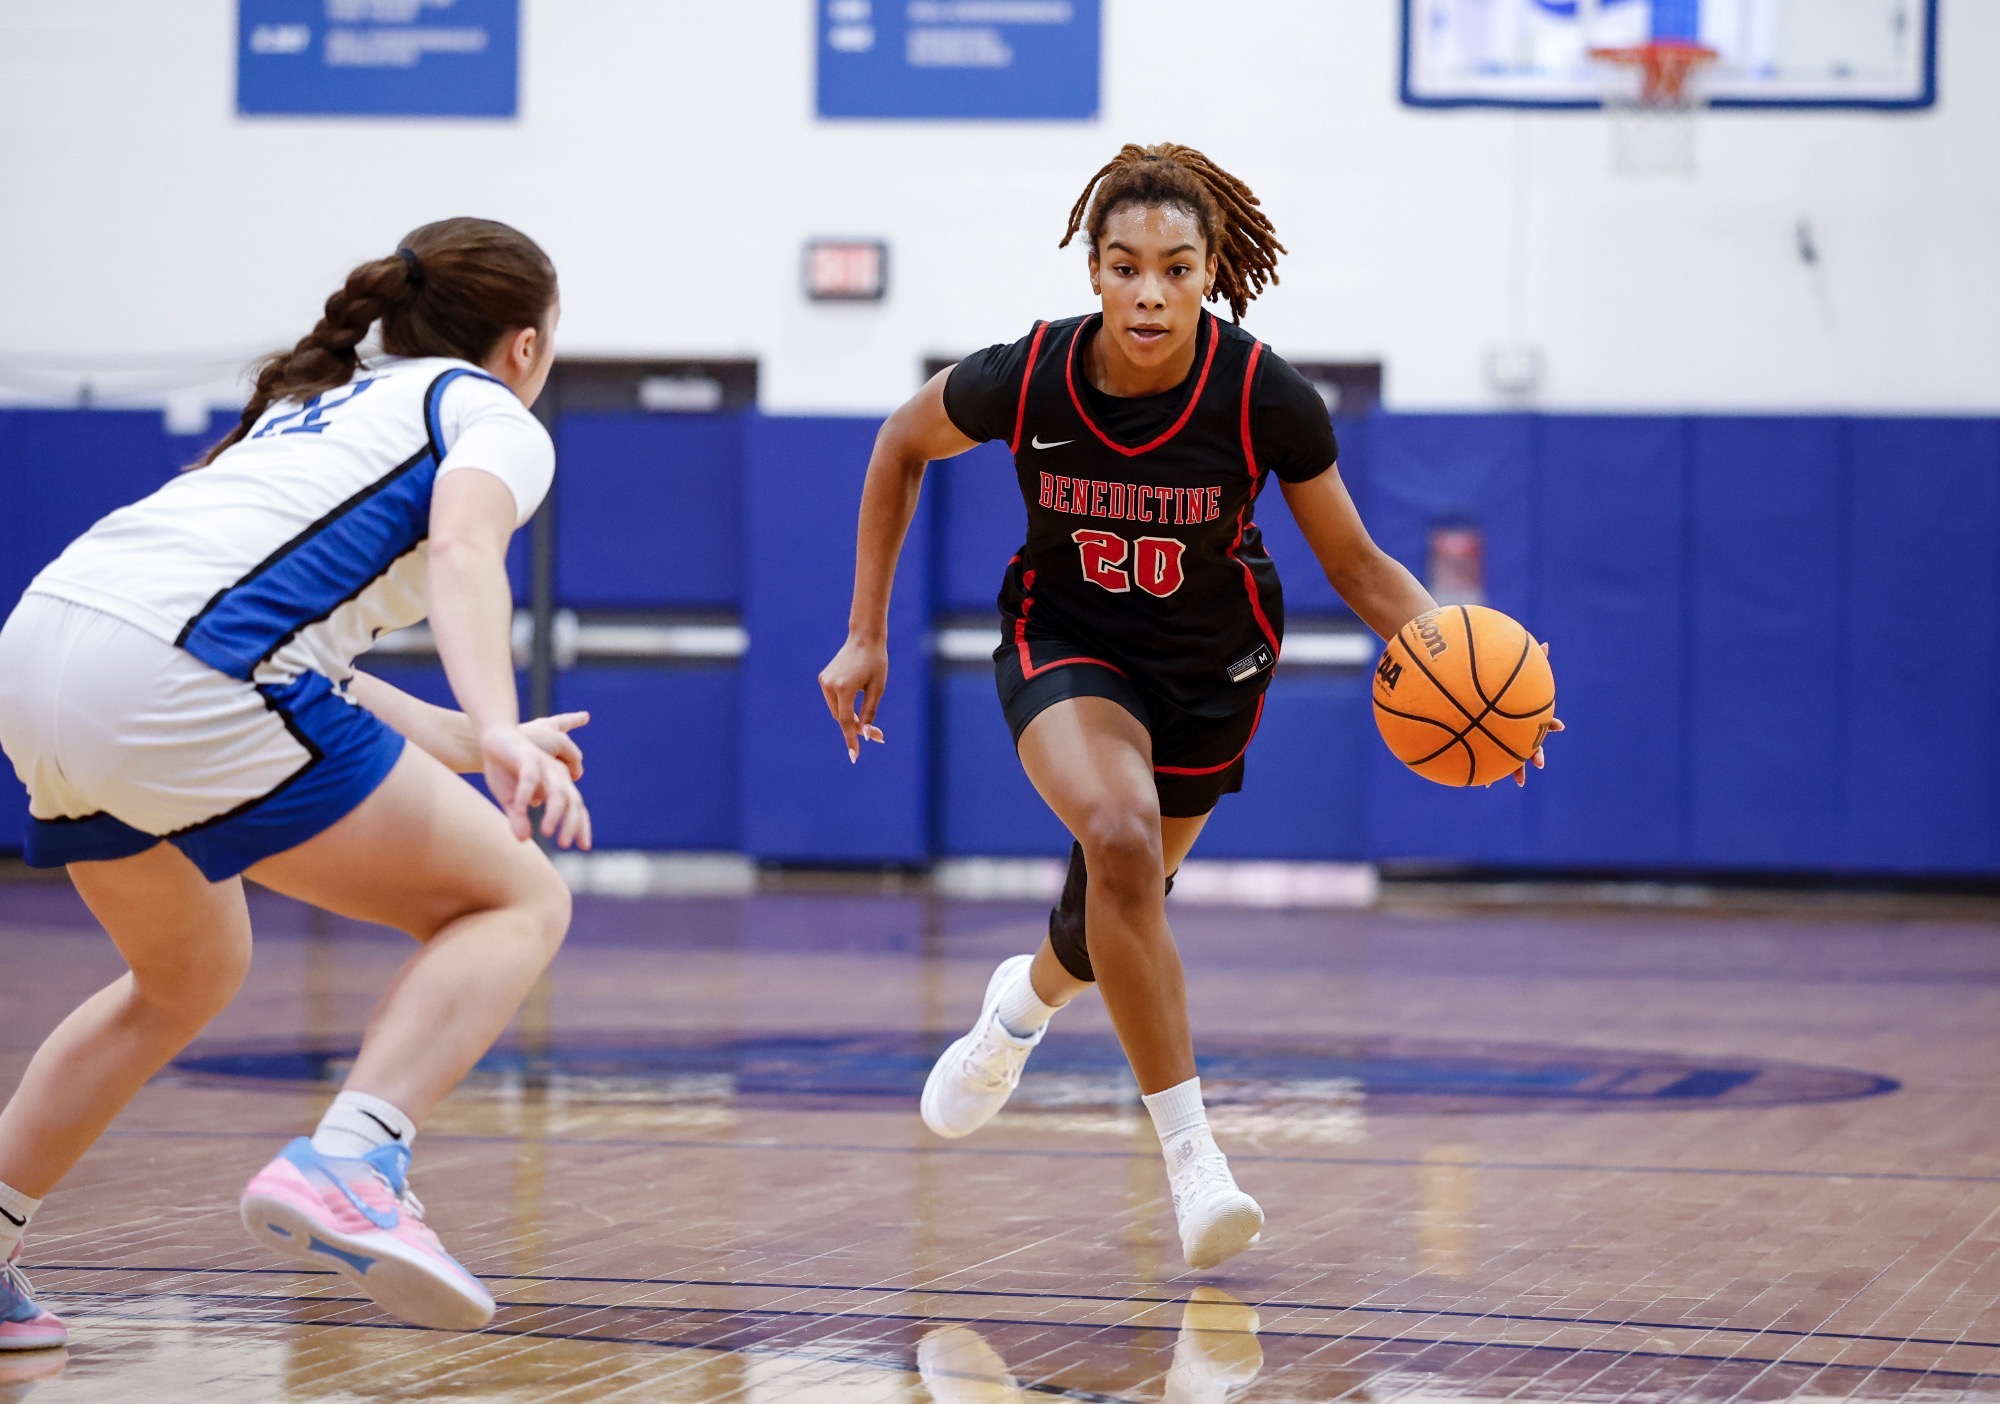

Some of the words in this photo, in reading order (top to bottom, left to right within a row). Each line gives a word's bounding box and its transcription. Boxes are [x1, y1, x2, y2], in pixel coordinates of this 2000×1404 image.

[1039, 471, 1222, 524] BENEDICTINE
[1071, 528, 1186, 598] 20
[1258, 652, 1268, 664] M
